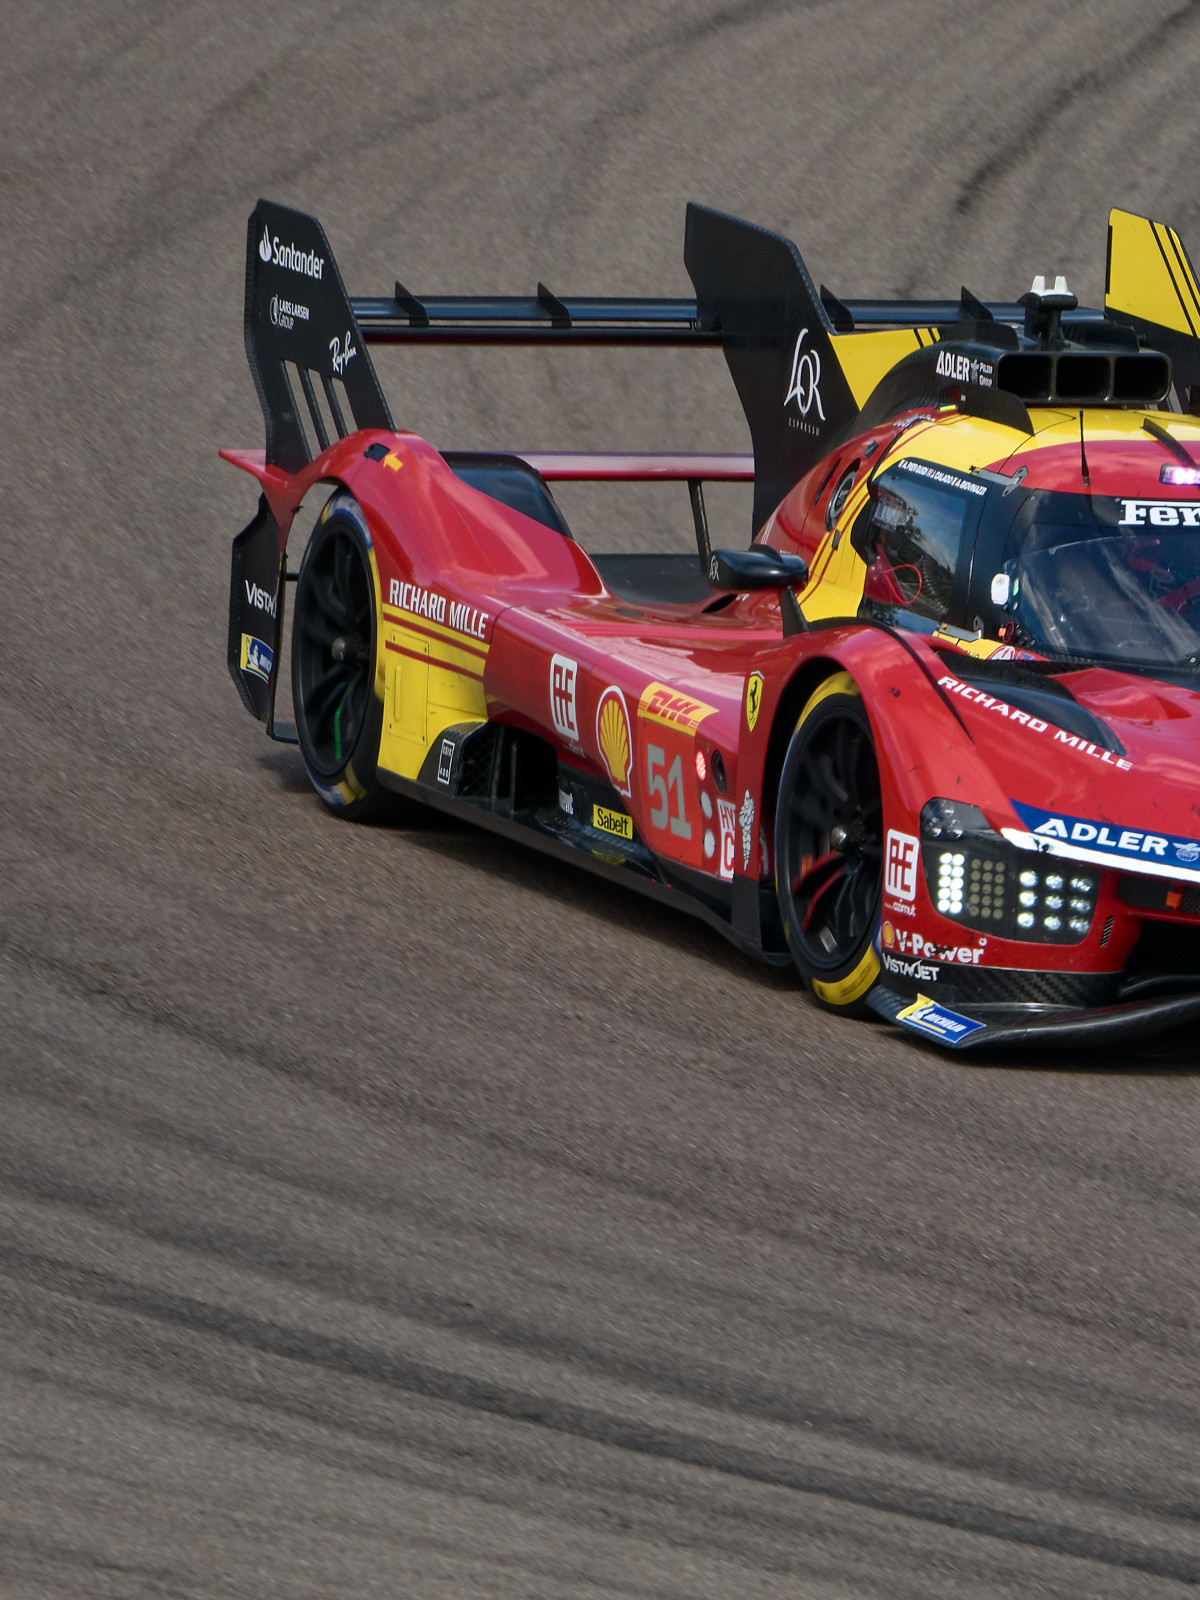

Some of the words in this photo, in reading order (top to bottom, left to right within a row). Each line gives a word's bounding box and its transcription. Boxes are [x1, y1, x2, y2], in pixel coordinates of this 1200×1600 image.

[272, 236, 325, 280] Santander
[279, 299, 292, 315] LARS
[291, 303, 310, 320] LARSEN
[279, 312, 295, 330] GROUP
[936, 350, 970, 382] ADLER
[788, 417, 819, 437] ESPRESSO
[389, 578, 446, 623] RICHARD
[449, 601, 489, 639] MILLE
[647, 689, 701, 728] DHL
[937, 675, 1048, 733] RICHARD
[1054, 729, 1133, 771] MILLE
[646, 743, 692, 841] 51
[597, 807, 629, 836] Sabelt
[1033, 817, 1169, 856] ADLER
[895, 928, 985, 964] V-Power
[882, 952, 940, 981] VISTAJET
[923, 1012, 968, 1034] MICHELIN
